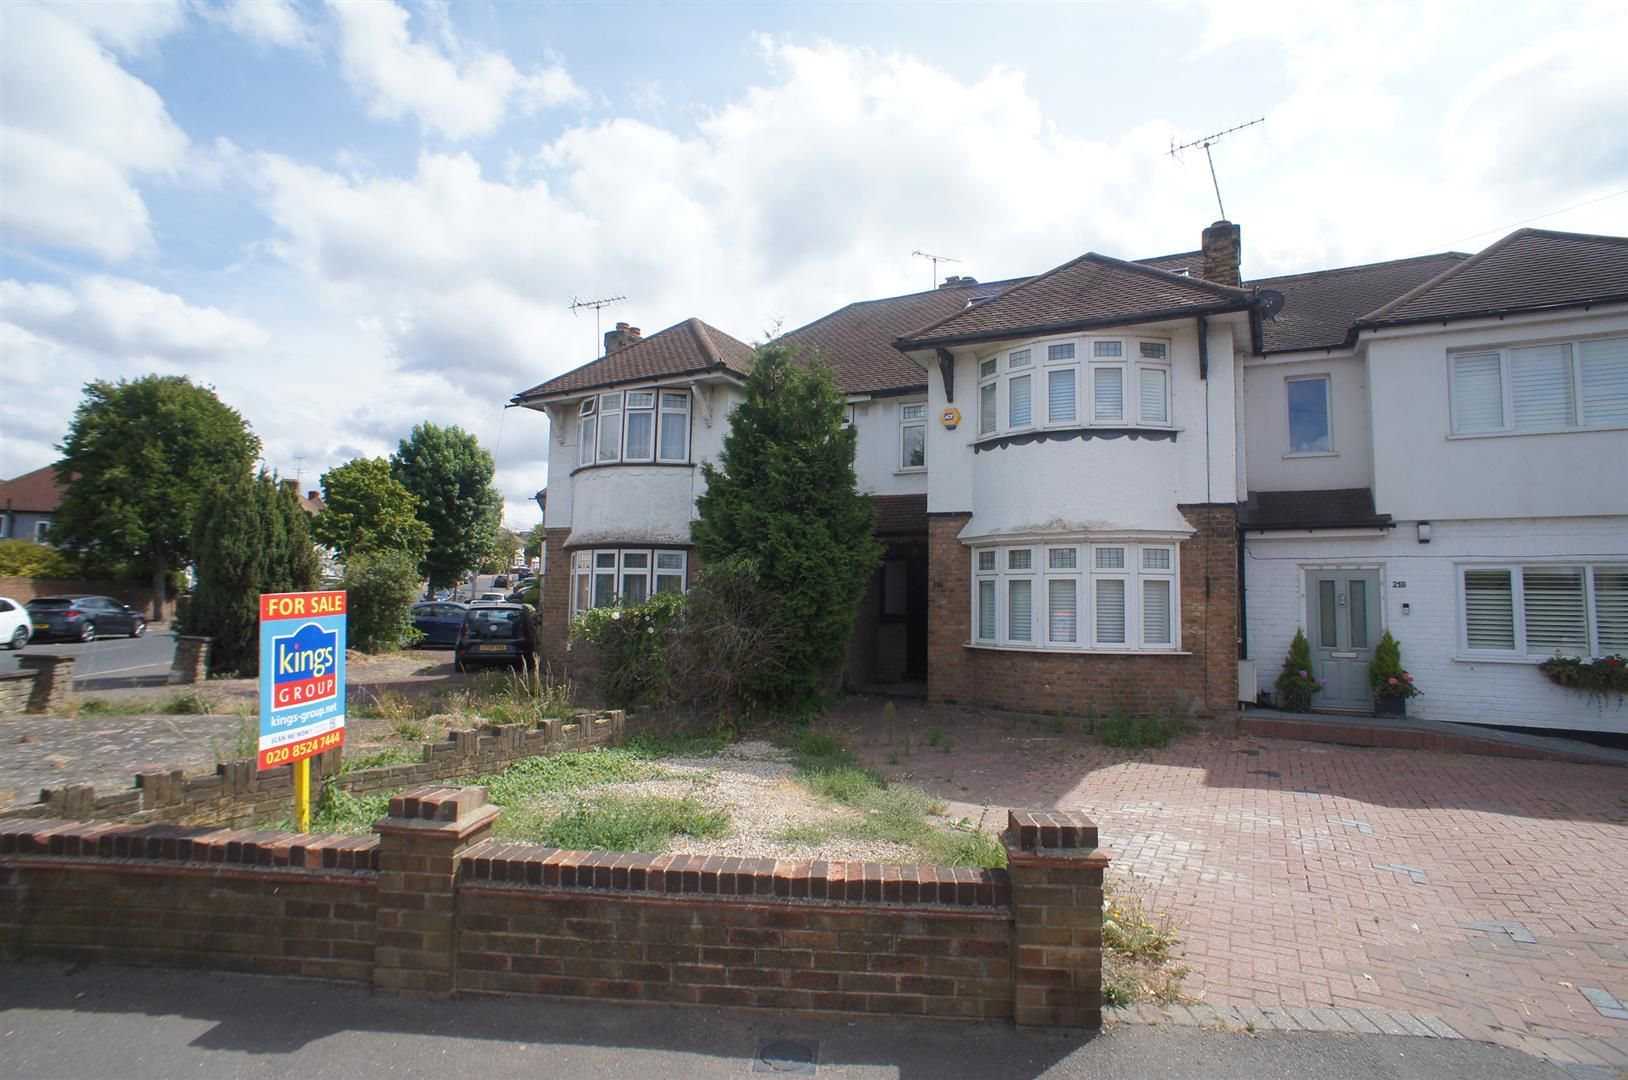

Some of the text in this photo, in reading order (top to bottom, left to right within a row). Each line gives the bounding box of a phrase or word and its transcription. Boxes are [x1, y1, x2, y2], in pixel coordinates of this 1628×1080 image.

[268, 595, 342, 616] FOR SALE
[279, 643, 333, 678] kings
[279, 679, 333, 703] GROUP
[271, 702, 337, 727] kings-group.net
[266, 730, 340, 764] 020 8524 7444
